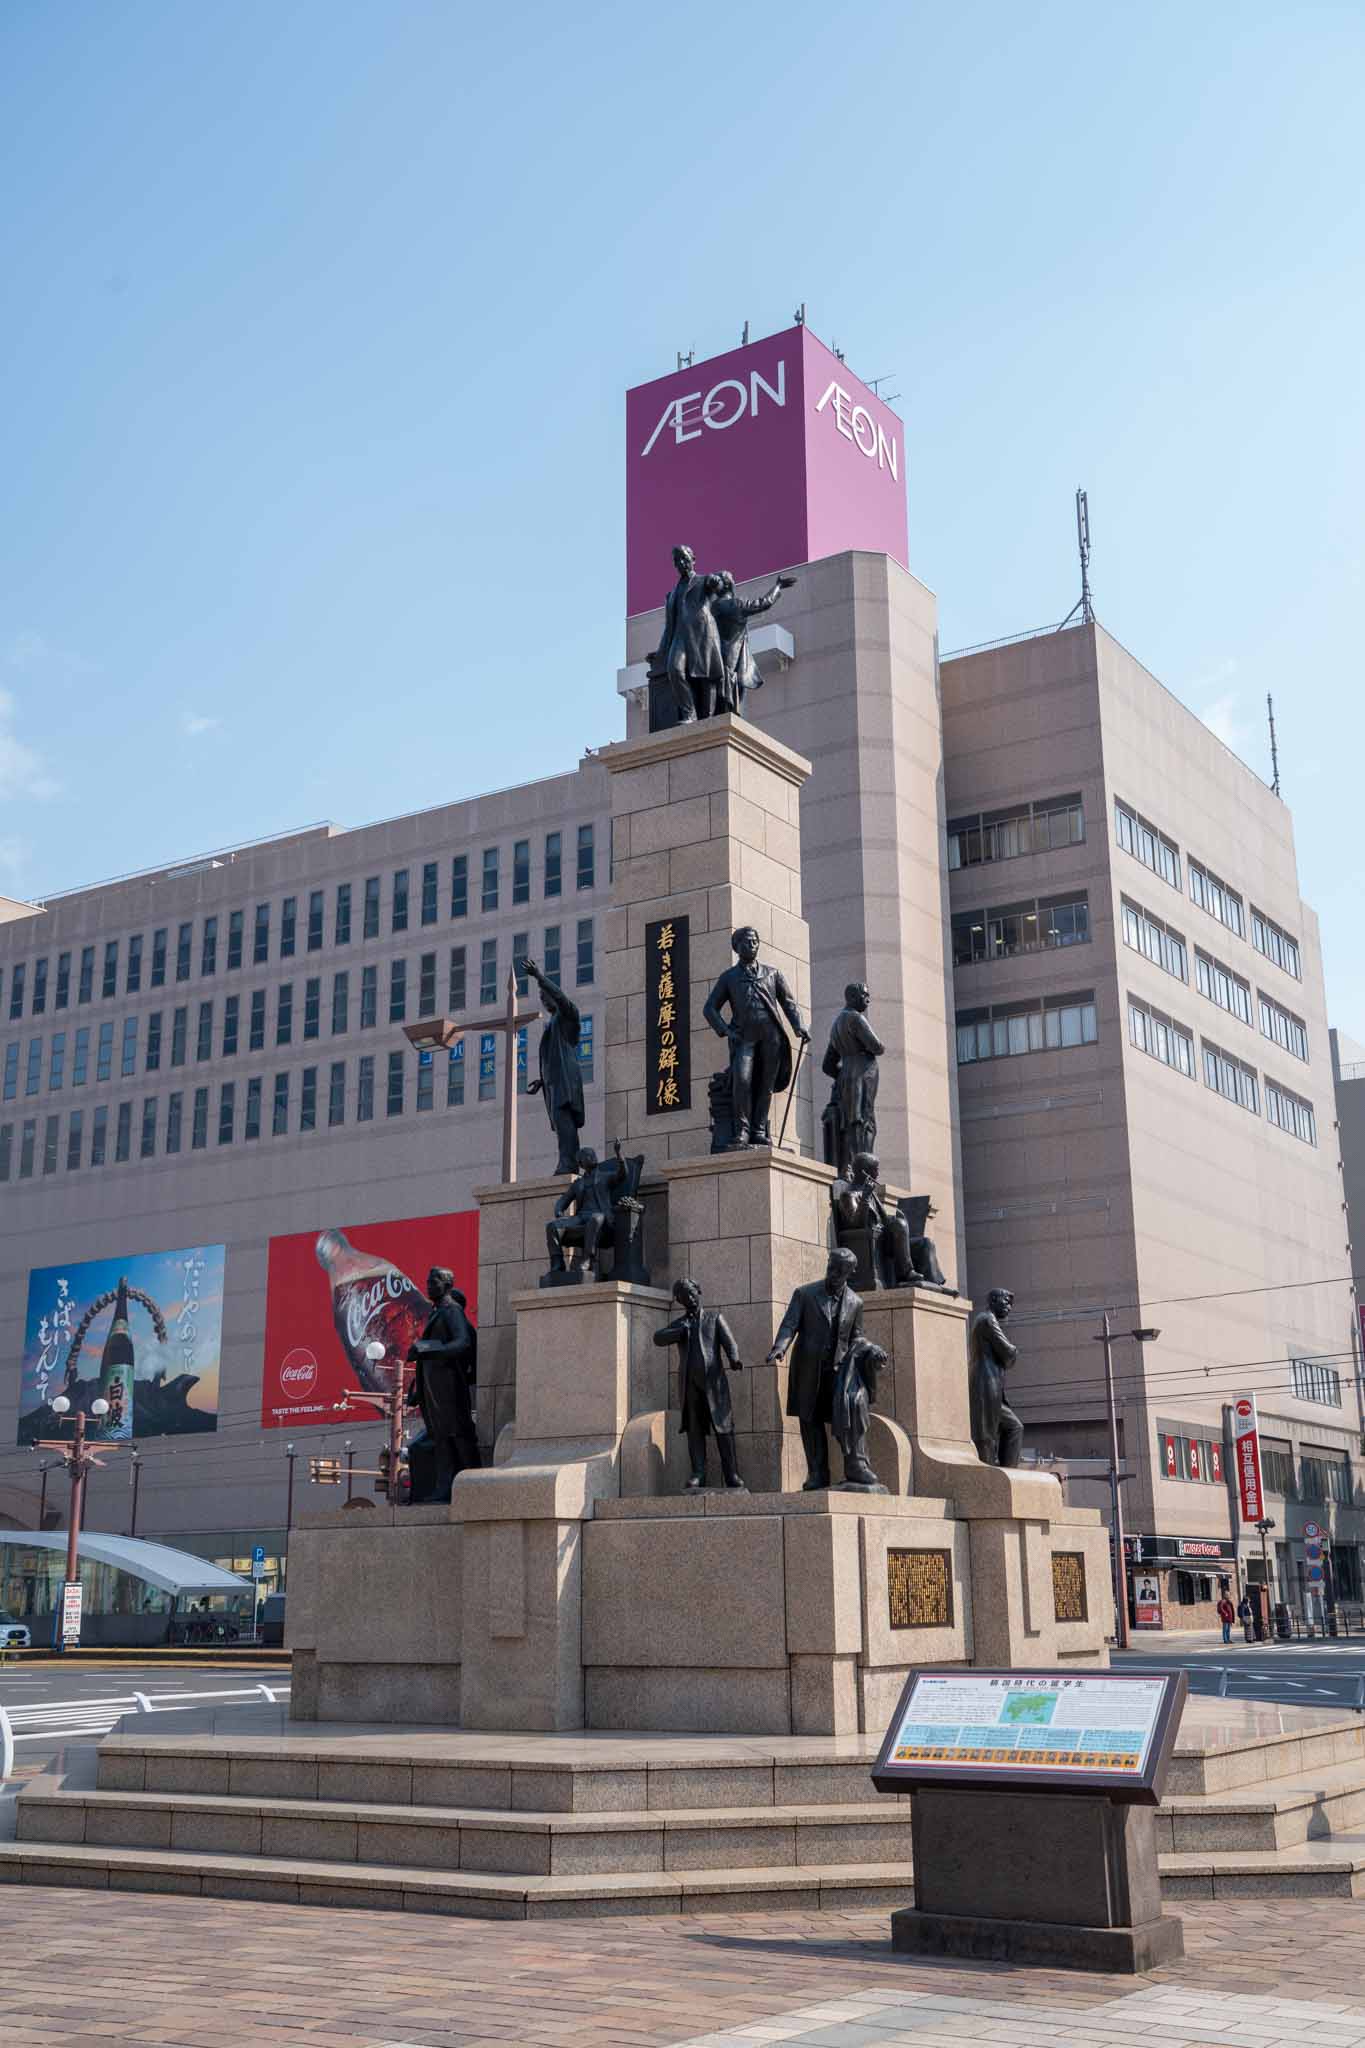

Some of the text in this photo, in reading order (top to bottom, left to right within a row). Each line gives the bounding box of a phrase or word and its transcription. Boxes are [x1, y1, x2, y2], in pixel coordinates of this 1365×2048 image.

[656, 923, 680, 1106] 若き薩摩の群像
[256, 1548, 264, 1561] P
